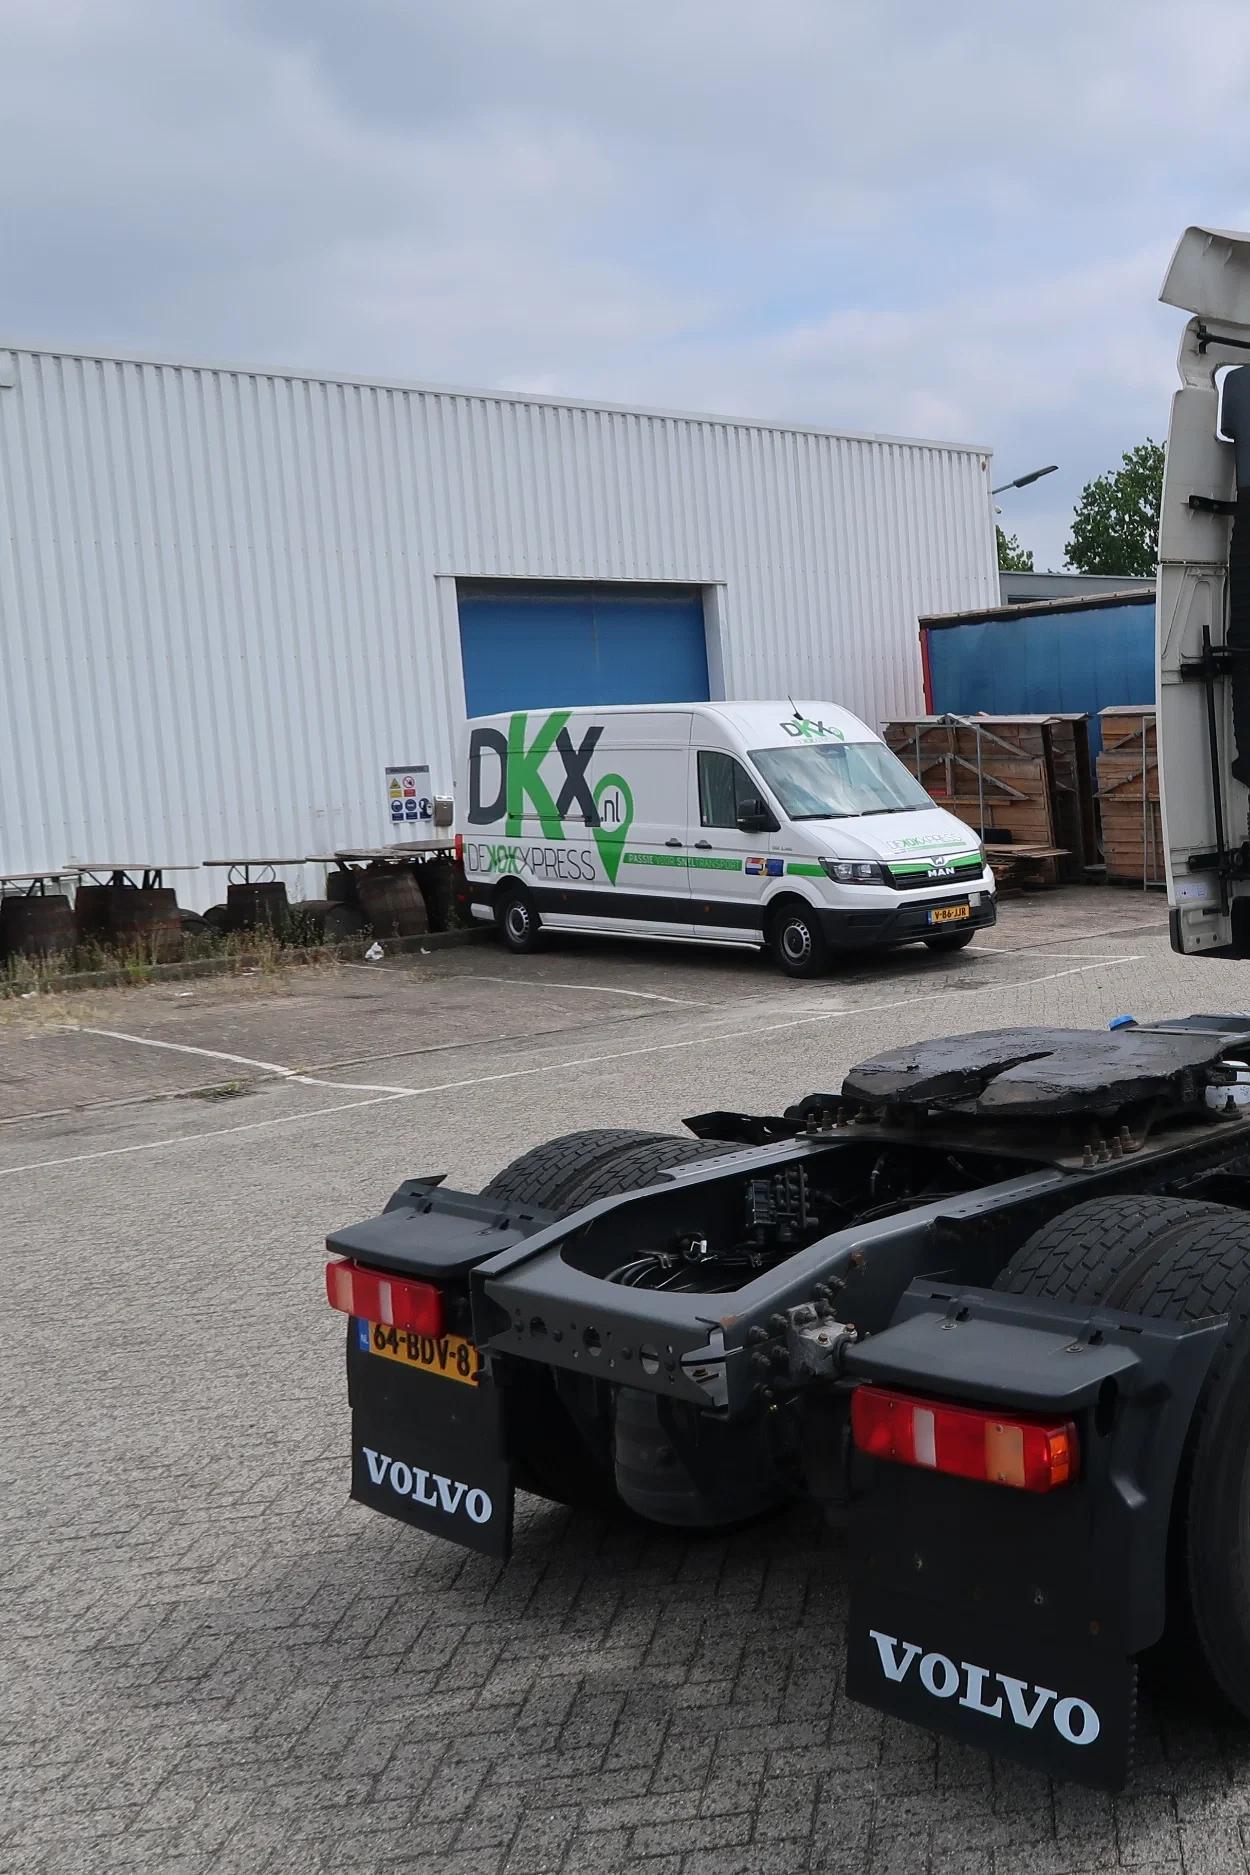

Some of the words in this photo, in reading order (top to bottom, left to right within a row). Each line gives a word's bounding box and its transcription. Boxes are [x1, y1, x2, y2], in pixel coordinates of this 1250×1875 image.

[468, 711, 604, 840] DKX
[629, 854, 654, 864] PASSIE
[927, 867, 955, 878] MAN
[935, 907, 966, 920] V-86-JJR
[374, 1324, 470, 1377] 64-BDV-8
[362, 1446, 493, 1525] VOLVO
[869, 1629, 1102, 1746] VOLVO
